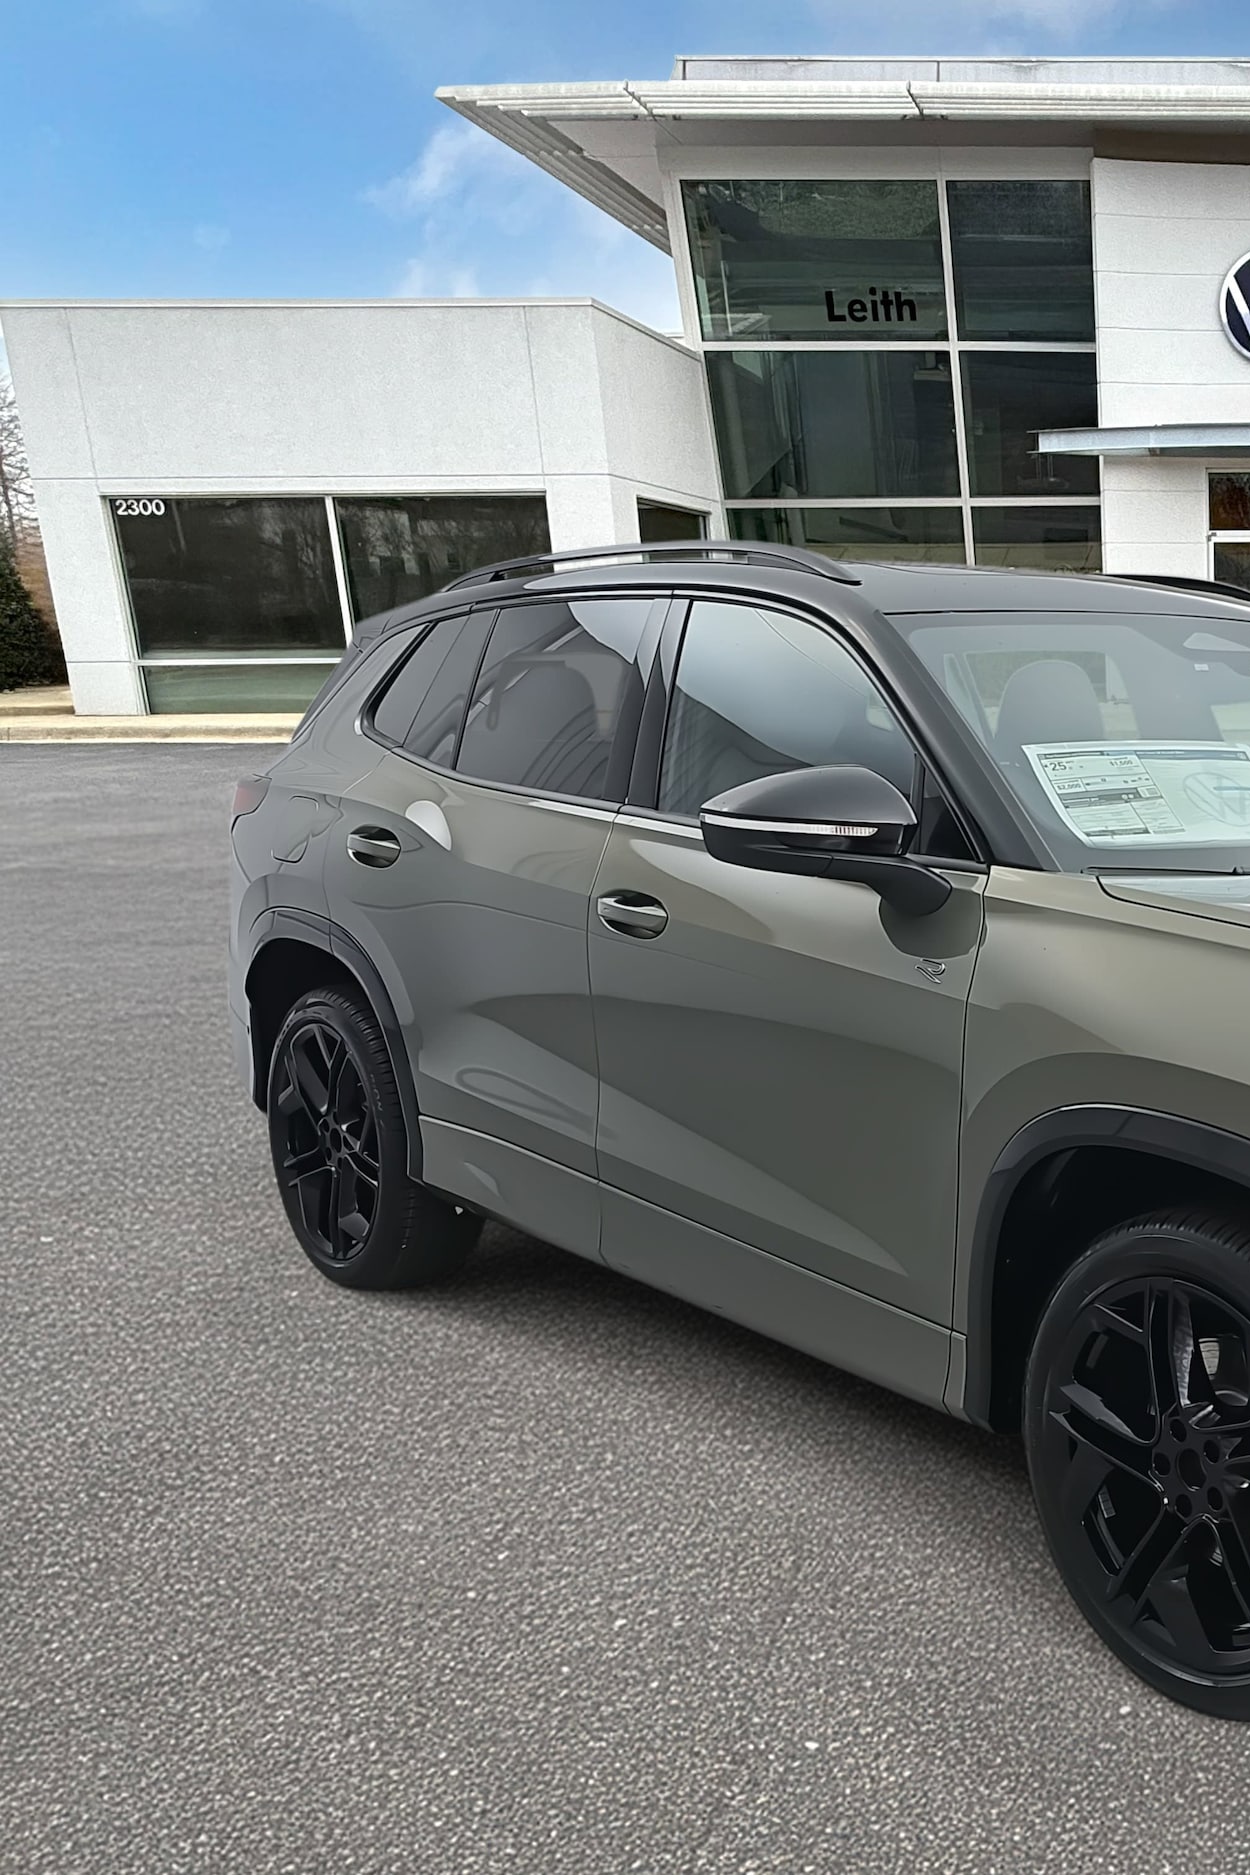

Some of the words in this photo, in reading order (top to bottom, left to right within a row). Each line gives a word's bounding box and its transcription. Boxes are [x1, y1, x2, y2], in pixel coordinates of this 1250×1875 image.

[825, 287, 917, 322] Leith
[115, 499, 166, 516] 2300
[1050, 761, 1068, 772] 25
